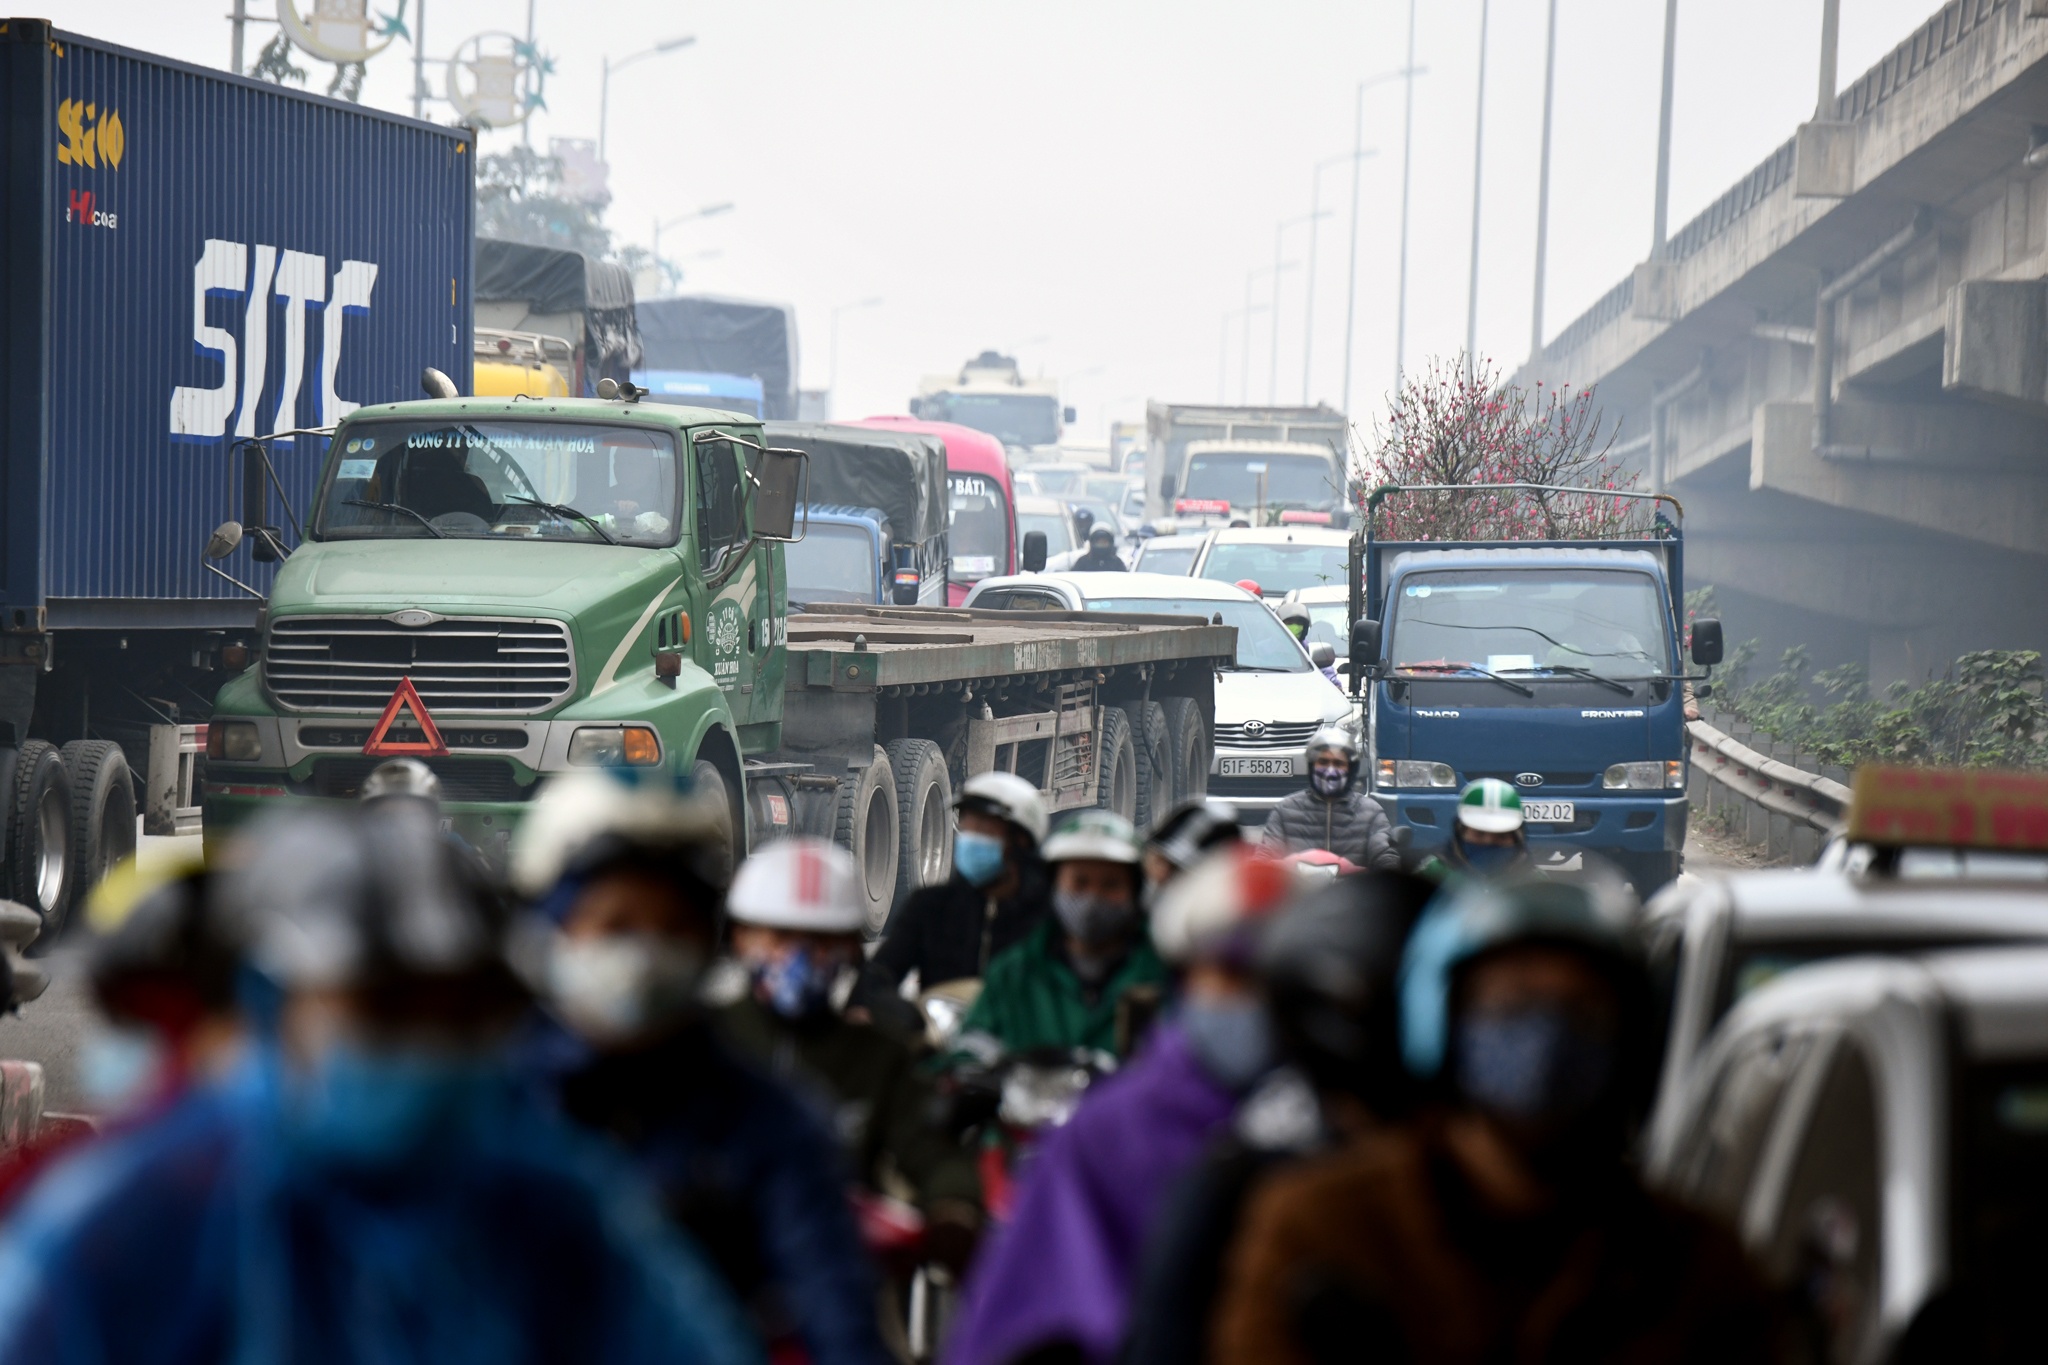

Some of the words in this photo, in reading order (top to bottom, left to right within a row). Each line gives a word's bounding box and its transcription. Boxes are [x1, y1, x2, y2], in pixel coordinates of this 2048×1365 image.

[171, 239, 378, 442] SITC
[445, 432, 463, 449] TY
[1415, 710, 1460, 719] THACO
[1222, 760, 1290, 774] 51F-558.73
